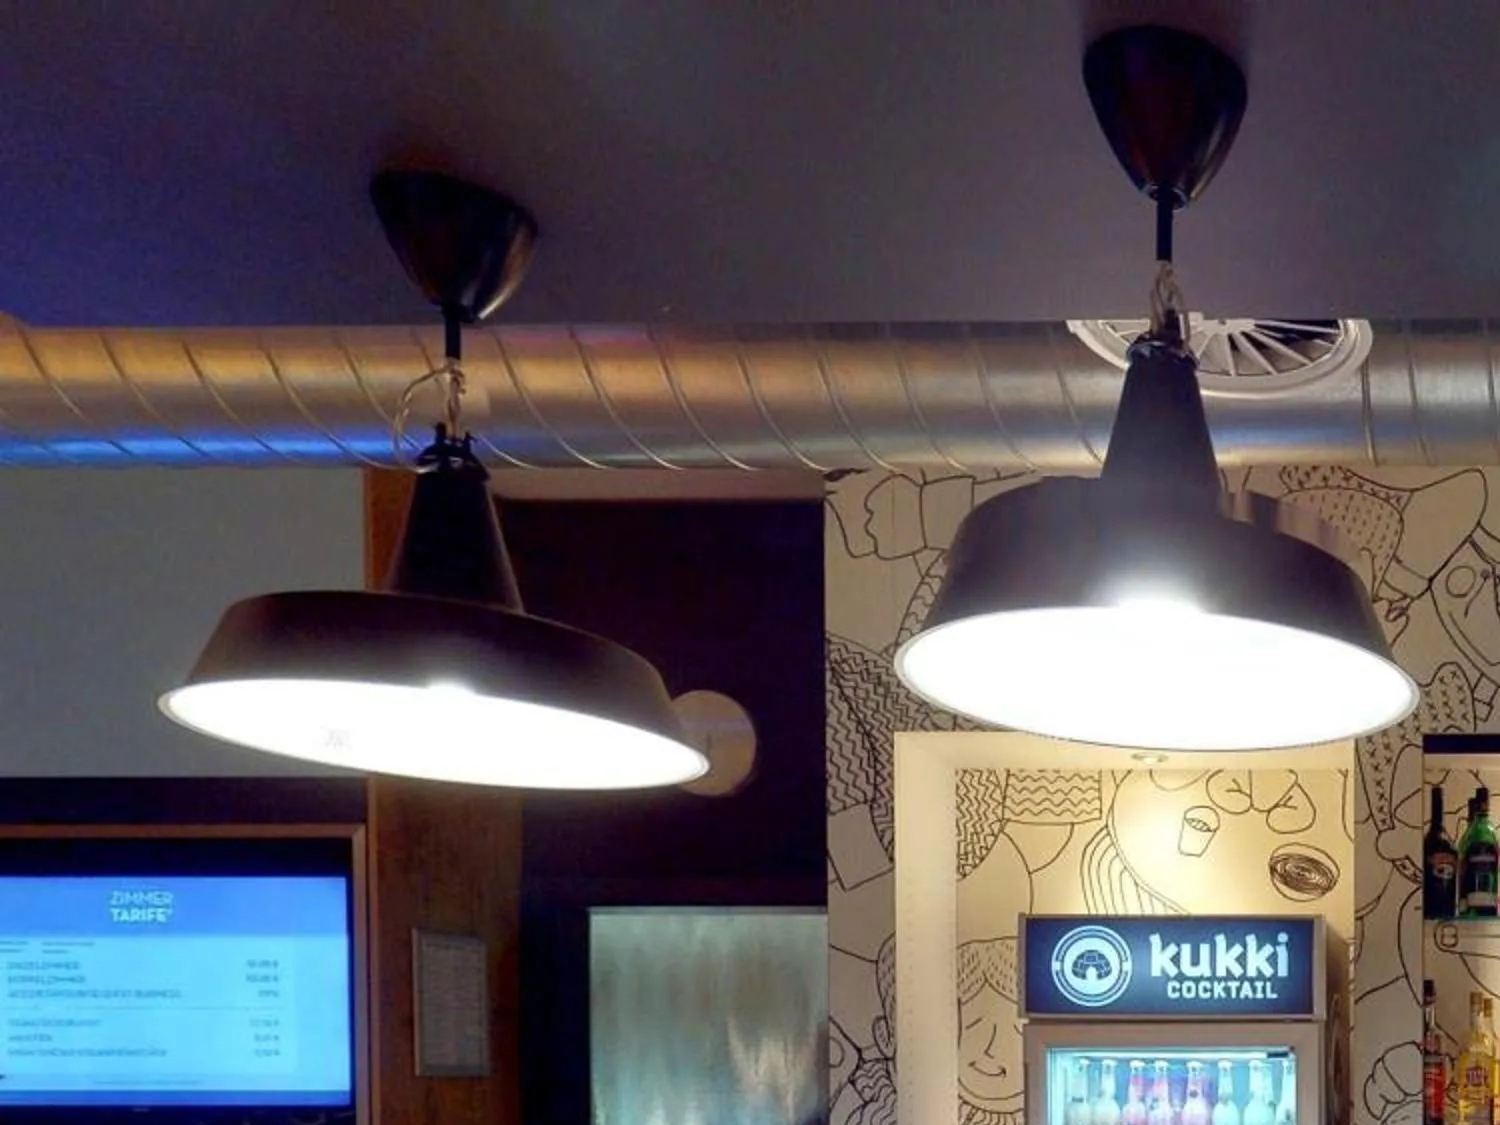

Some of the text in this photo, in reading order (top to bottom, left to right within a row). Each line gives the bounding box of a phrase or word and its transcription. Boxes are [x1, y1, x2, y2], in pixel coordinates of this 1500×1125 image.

[110, 891, 174, 906] ZIMMER
[1149, 932, 1289, 978] kukki
[1167, 980, 1278, 999] COCKTAIL
